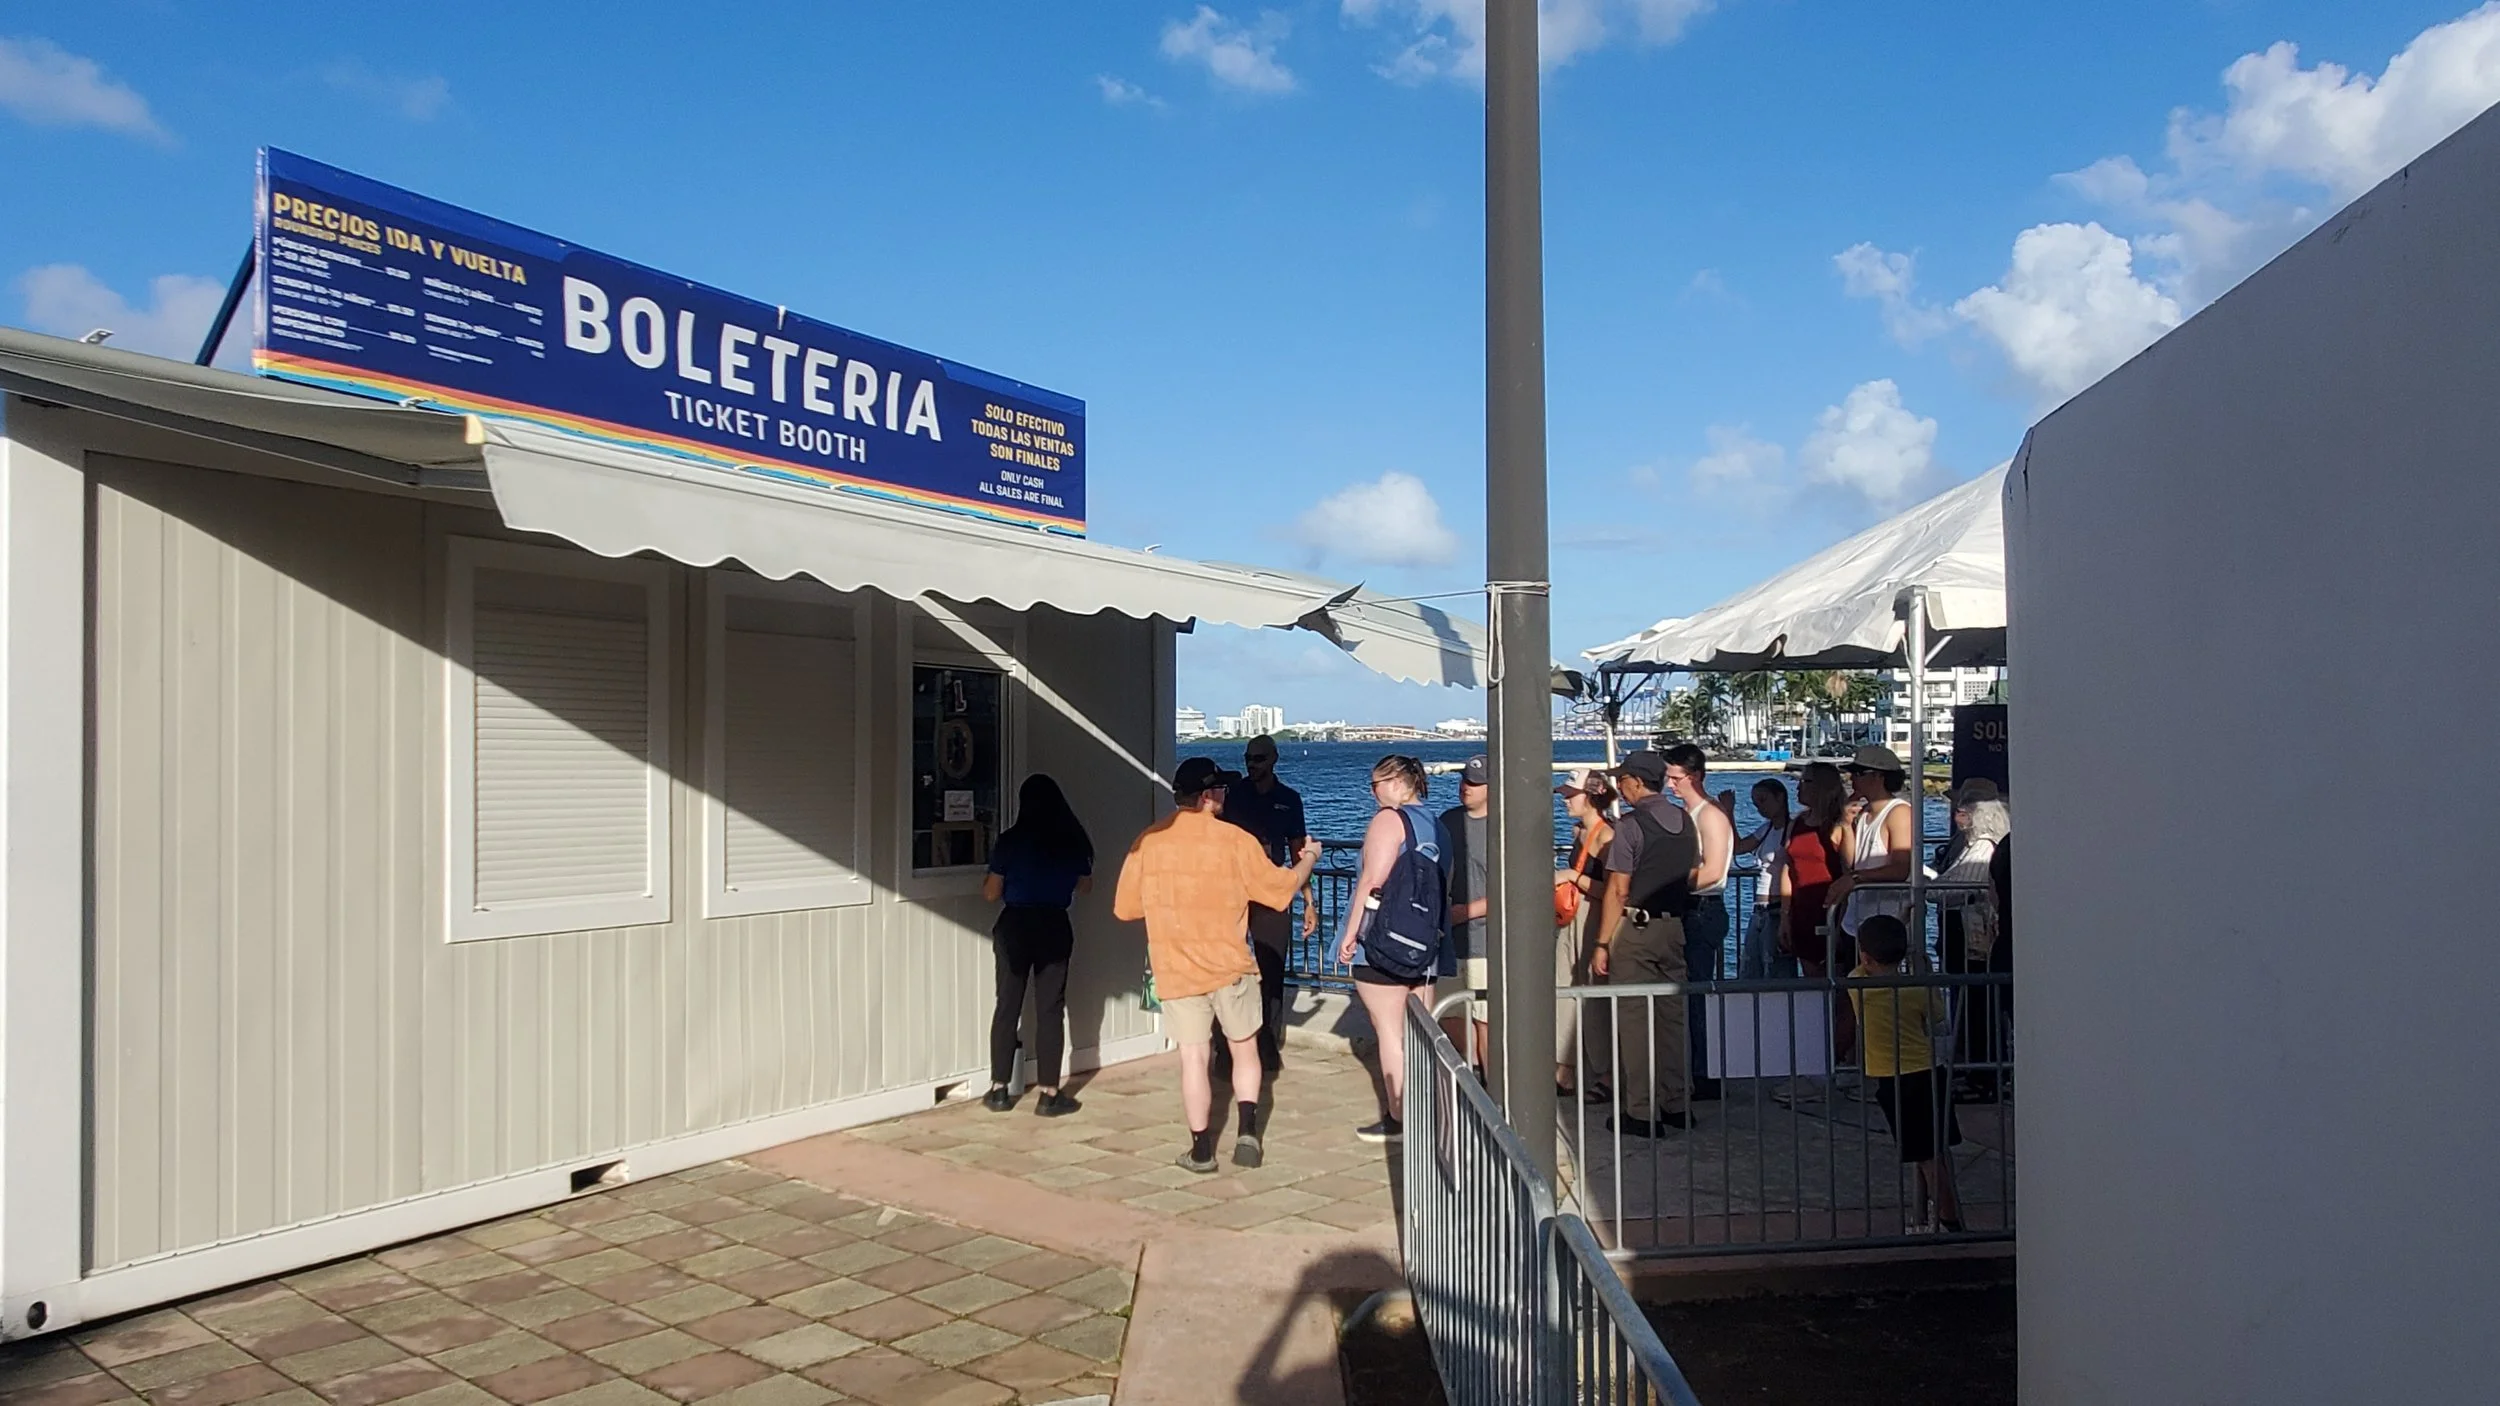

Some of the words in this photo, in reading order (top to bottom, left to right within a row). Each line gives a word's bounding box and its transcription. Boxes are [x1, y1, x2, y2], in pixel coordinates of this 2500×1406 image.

[273, 192, 381, 241] PRECIOS
[385, 226, 427, 255] IDA
[429, 239, 445, 260] Y
[448, 245, 528, 286] VUELTA
[563, 275, 942, 442] BOLETERIA
[664, 390, 770, 441] TICKET
[779, 419, 867, 464] BOOTH
[971, 419, 1008, 441] TODAS
[1011, 429, 1031, 447] LAS
[1033, 434, 1075, 457] VENTAS
[985, 403, 1013, 423] SOLO
[1016, 411, 1065, 437] EFECTIVO
[990, 443, 1013, 461] SON
[1016, 448, 1060, 472] FINALES
[979, 481, 995, 495] ALL
[996, 484, 1022, 501] SALES
[1023, 491, 1040, 503] ARE
[1041, 495, 1064, 508] FINAL
[1001, 470, 1021, 485] ONLY
[1022, 474, 1044, 489] CASH
